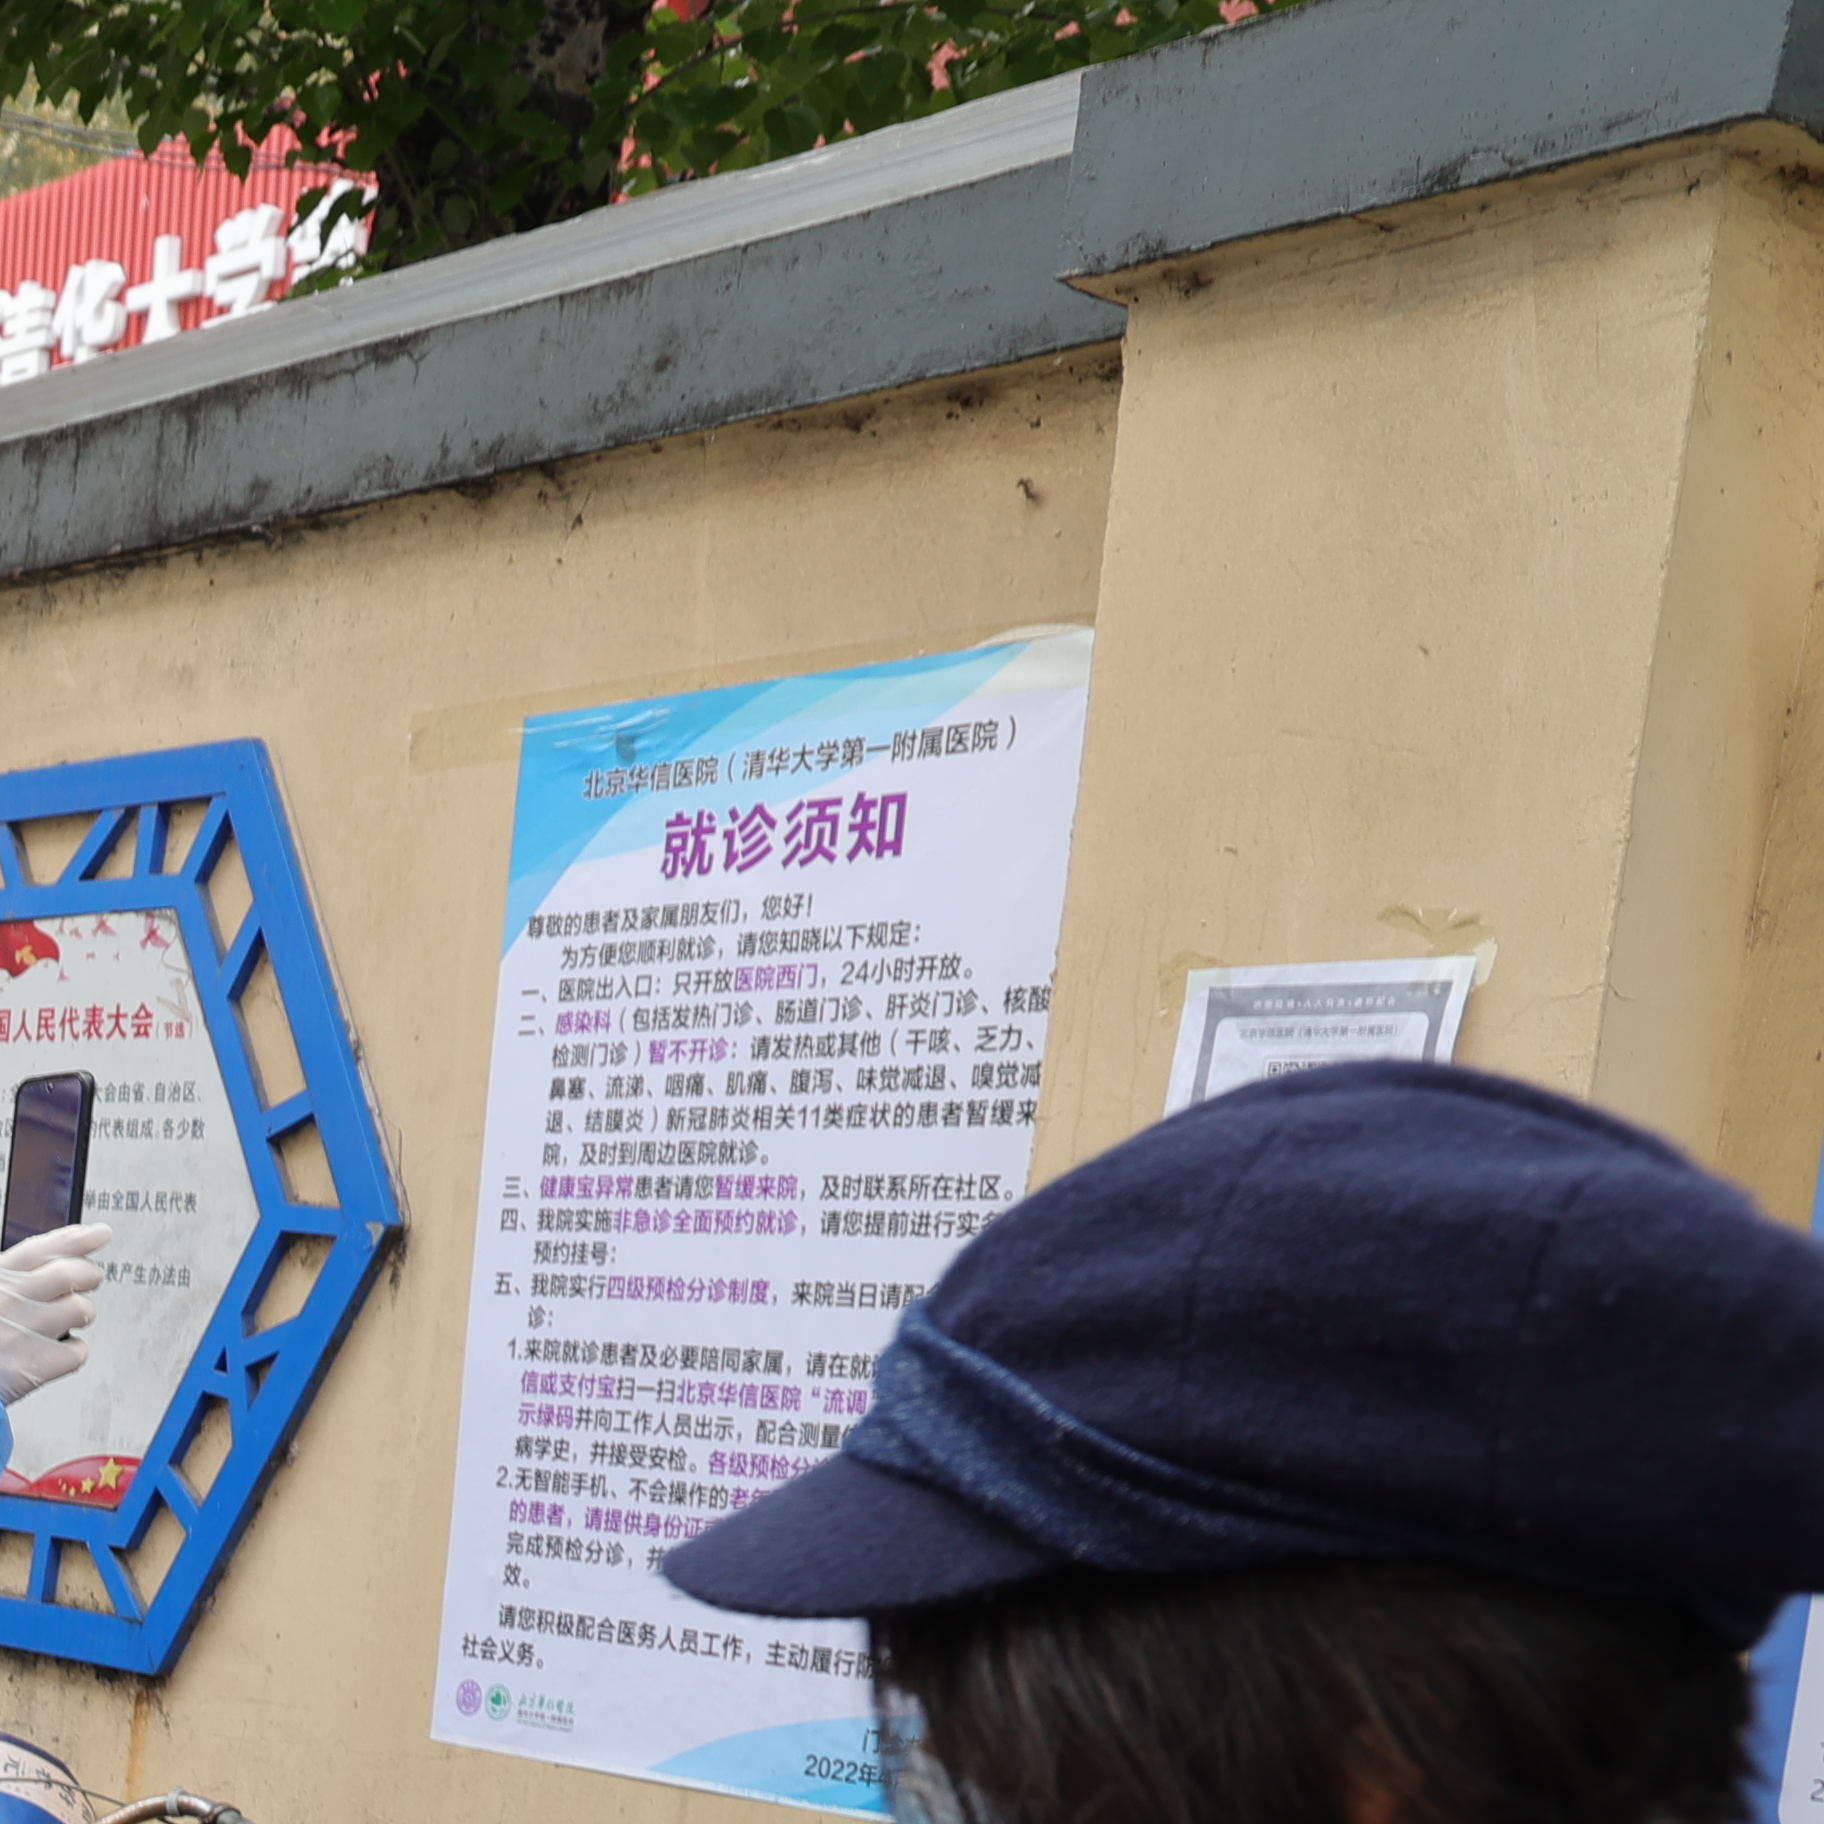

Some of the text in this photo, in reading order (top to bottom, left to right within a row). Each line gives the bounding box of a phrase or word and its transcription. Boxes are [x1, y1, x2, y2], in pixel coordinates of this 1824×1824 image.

[582, 714, 1018, 799] 北京华信医院（清华大学第一附属医院）
[660, 790, 909, 881] 就诊须知
[542, 1139, 769, 1168] 院，及时到周边医院就诊。
[517, 1402, 852, 1449] 示绿码并向工作人员出示，配合测量
[515, 1435, 829, 1480] 病学史，并接受安检。各级预检分
[461, 1633, 547, 1670] 社会义务。
[498, 1603, 878, 1681] 请您积极配合医务人员工作，主动履行防
